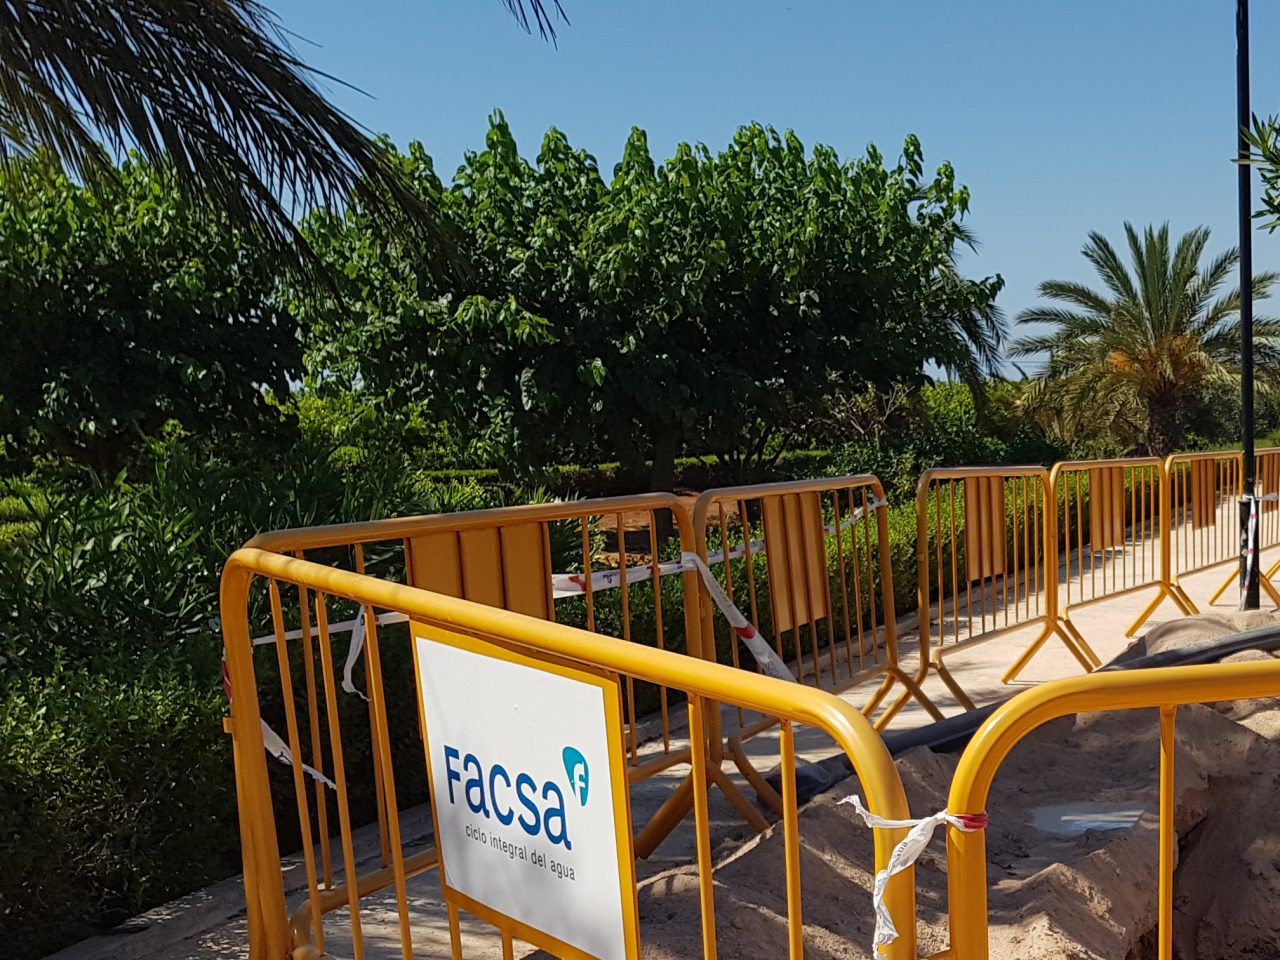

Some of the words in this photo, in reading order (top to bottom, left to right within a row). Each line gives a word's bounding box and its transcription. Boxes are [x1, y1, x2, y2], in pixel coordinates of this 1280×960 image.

[444, 744, 572, 851] Facsa
[465, 824, 487, 844] ciclo
[490, 831, 527, 861] integral
[531, 849, 546, 869] del
[550, 859, 575, 881] agua
